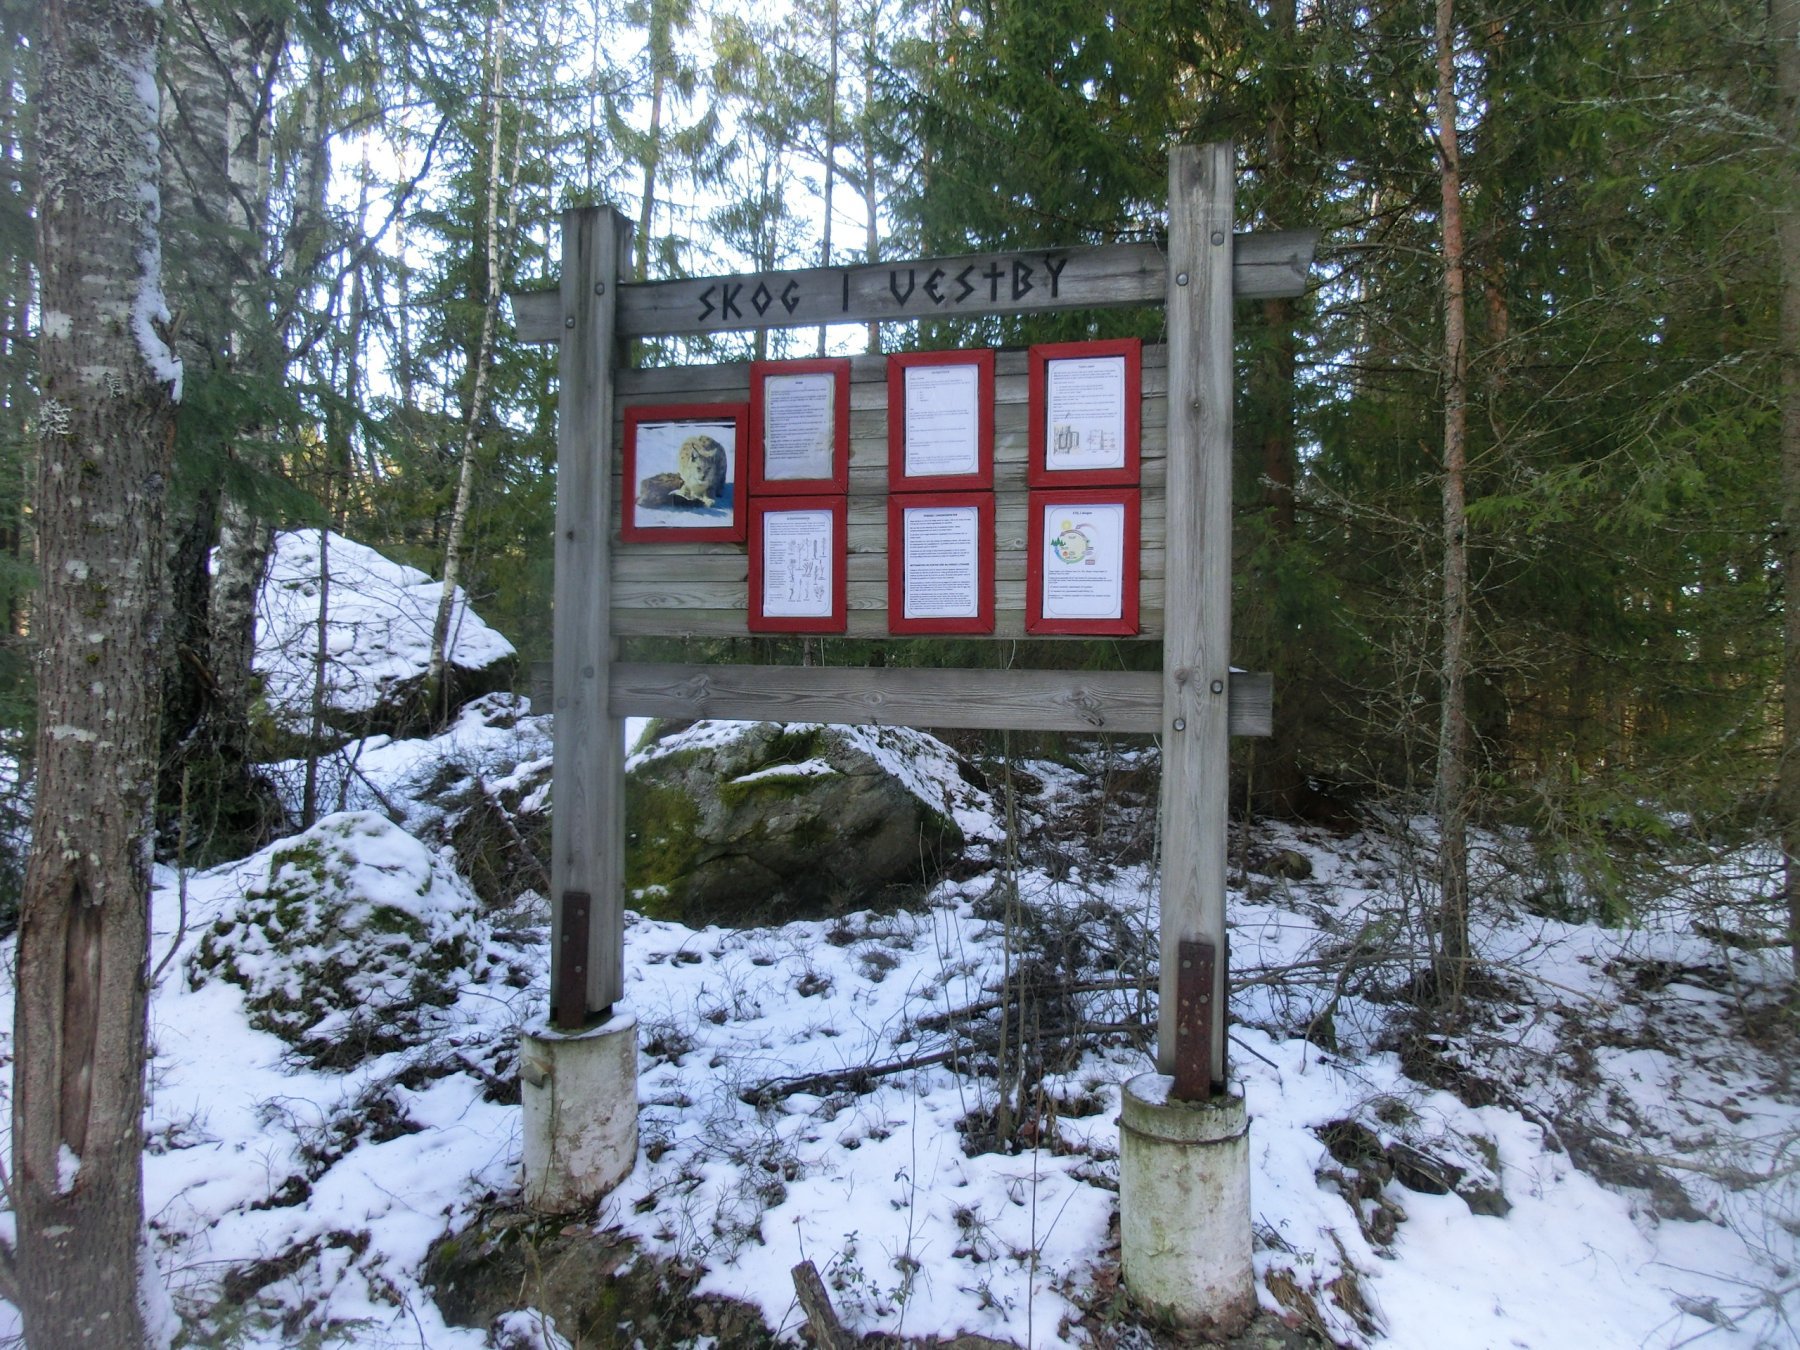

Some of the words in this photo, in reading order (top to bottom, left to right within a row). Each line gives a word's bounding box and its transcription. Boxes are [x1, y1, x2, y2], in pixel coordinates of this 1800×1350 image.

[697, 280, 800, 322] SKOG
[842, 273, 849, 312] I
[889, 254, 1067, 307] VESTBY
